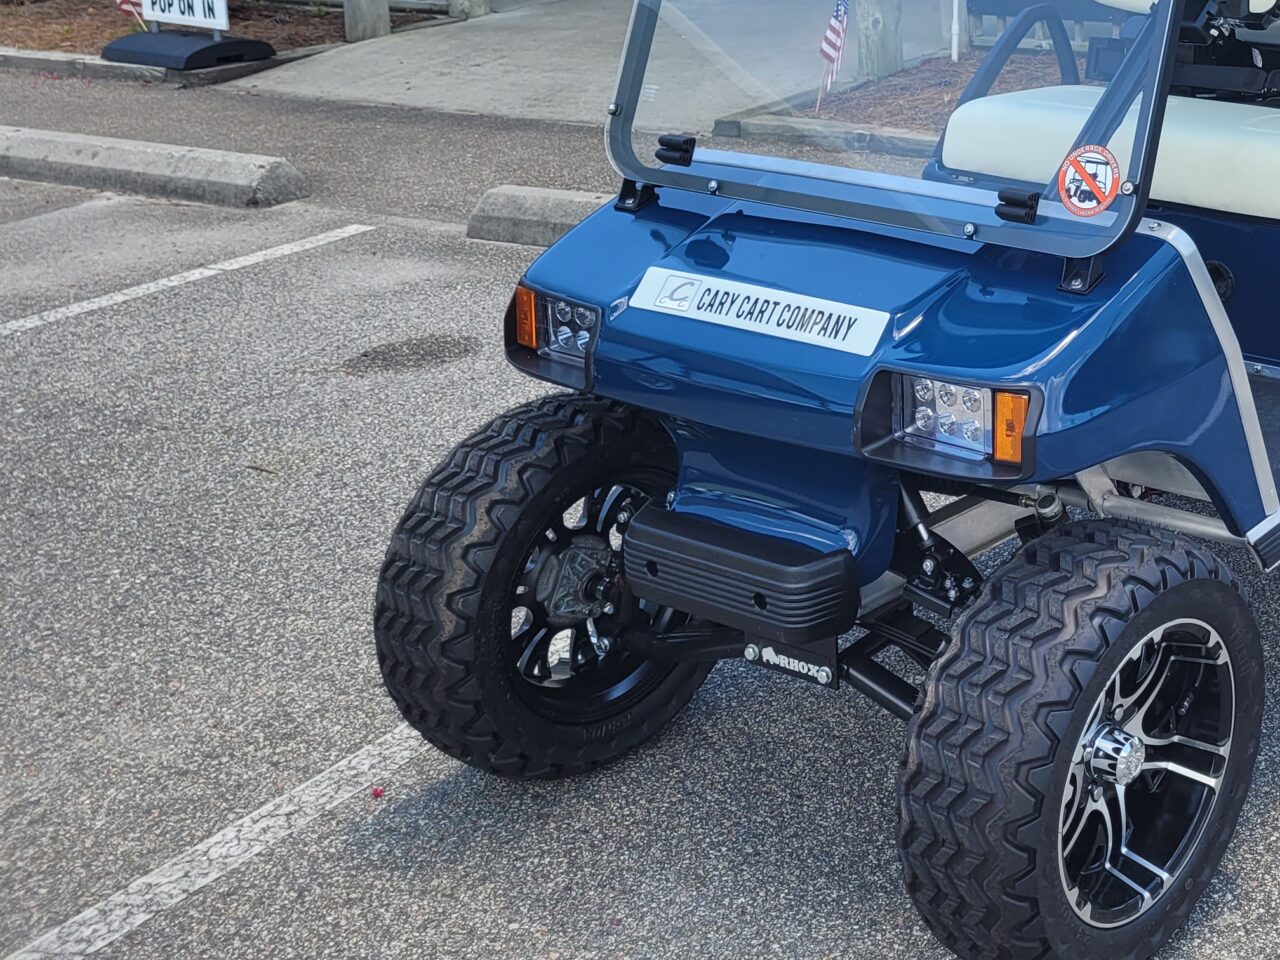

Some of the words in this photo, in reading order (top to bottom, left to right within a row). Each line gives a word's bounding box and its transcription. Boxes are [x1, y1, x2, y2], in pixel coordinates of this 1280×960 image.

[203, 0, 216, 20] IN
[1061, 160, 1070, 171] NO
[1069, 144, 1103, 160] UNDERAGE
[1103, 149, 1119, 178] DRIVERS
[697, 288, 739, 317] CARY
[735, 295, 780, 325] CART
[778, 304, 858, 341] COMPANY
[779, 653, 821, 677] RHOX
